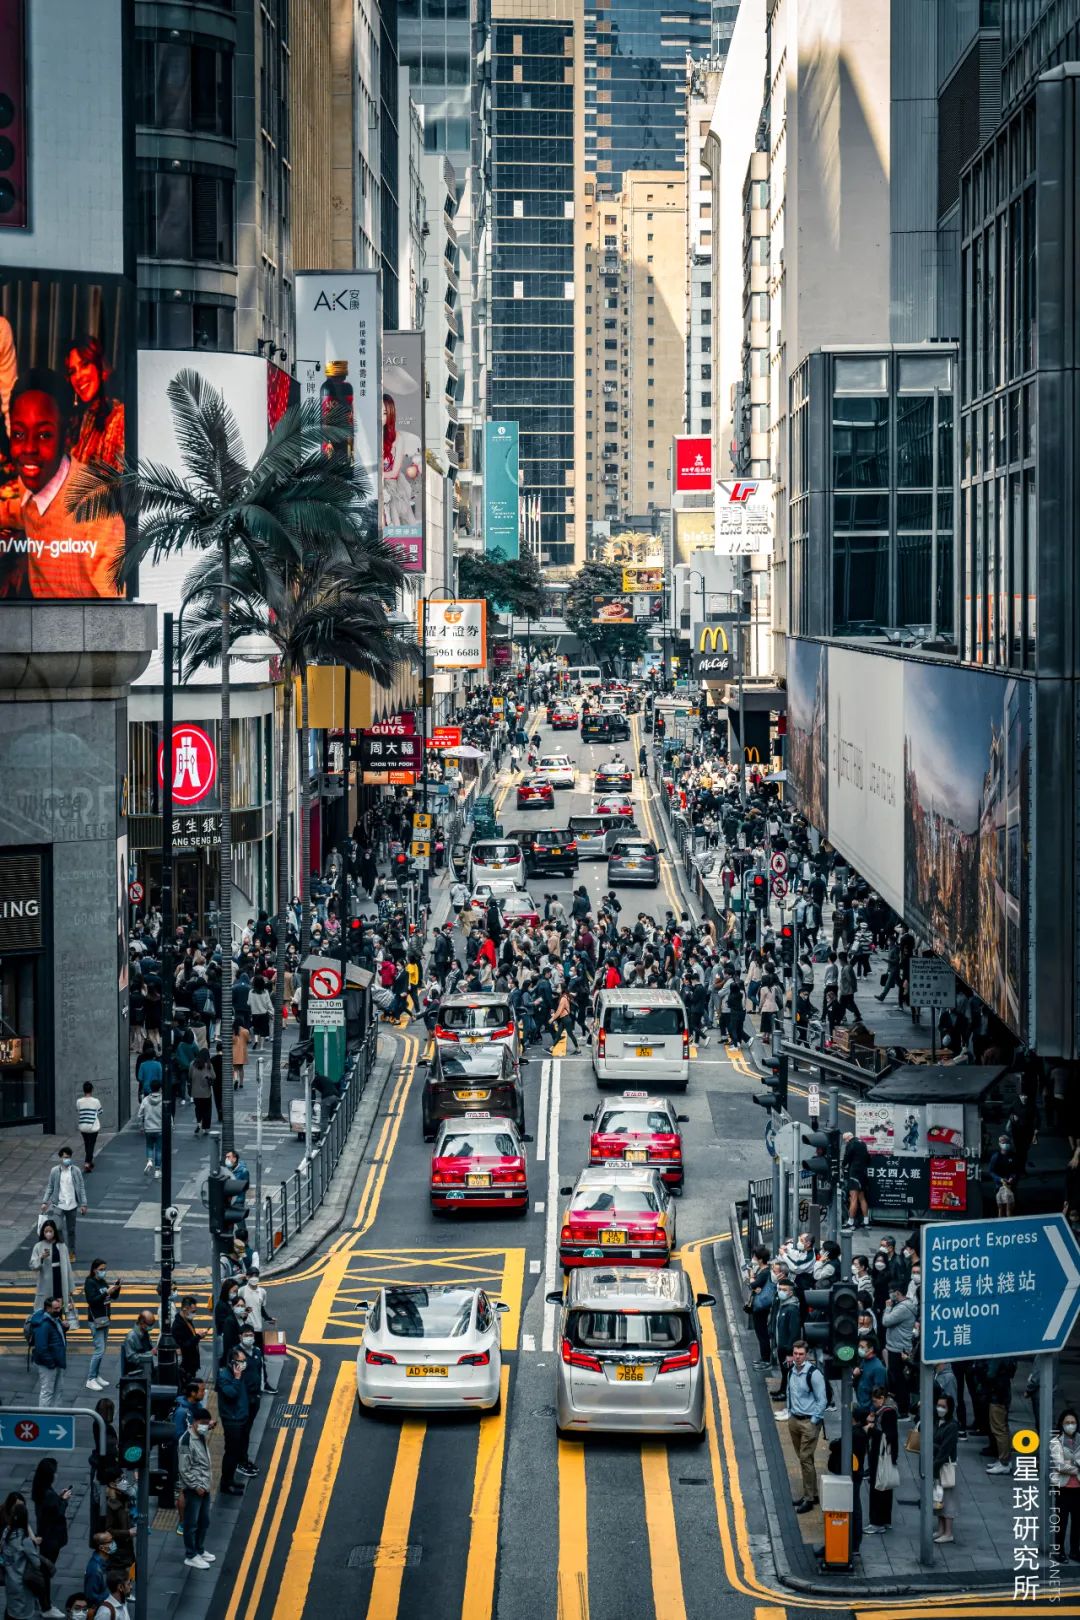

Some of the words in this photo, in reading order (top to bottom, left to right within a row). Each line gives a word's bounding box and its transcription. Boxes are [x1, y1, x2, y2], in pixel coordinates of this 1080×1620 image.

[383, 358, 407, 367] ACE
[457, 649, 479, 657] 6688
[382, 715, 402, 724] IVE
[371, 725, 406, 734] GUYS
[370, 741, 414, 754] 周大福
[172, 817, 222, 835] 恒生銀
[172, 838, 189, 846] ANG
[190, 837, 211, 845] SENG
[213, 836, 222, 844] BA
[867, 1167, 920, 1179] 日文四人班
[932, 1236, 981, 1251] Airport
[986, 1232, 1038, 1248] Express
[932, 1255, 990, 1272] Station
[933, 1270, 1036, 1299] 機場快綫站
[931, 1302, 1000, 1320] Kowloon
[932, 1324, 972, 1348] 九龍
[409, 1367, 420, 1375] AD
[422, 1367, 446, 1375] 9888
[624, 1365, 636, 1373] GV
